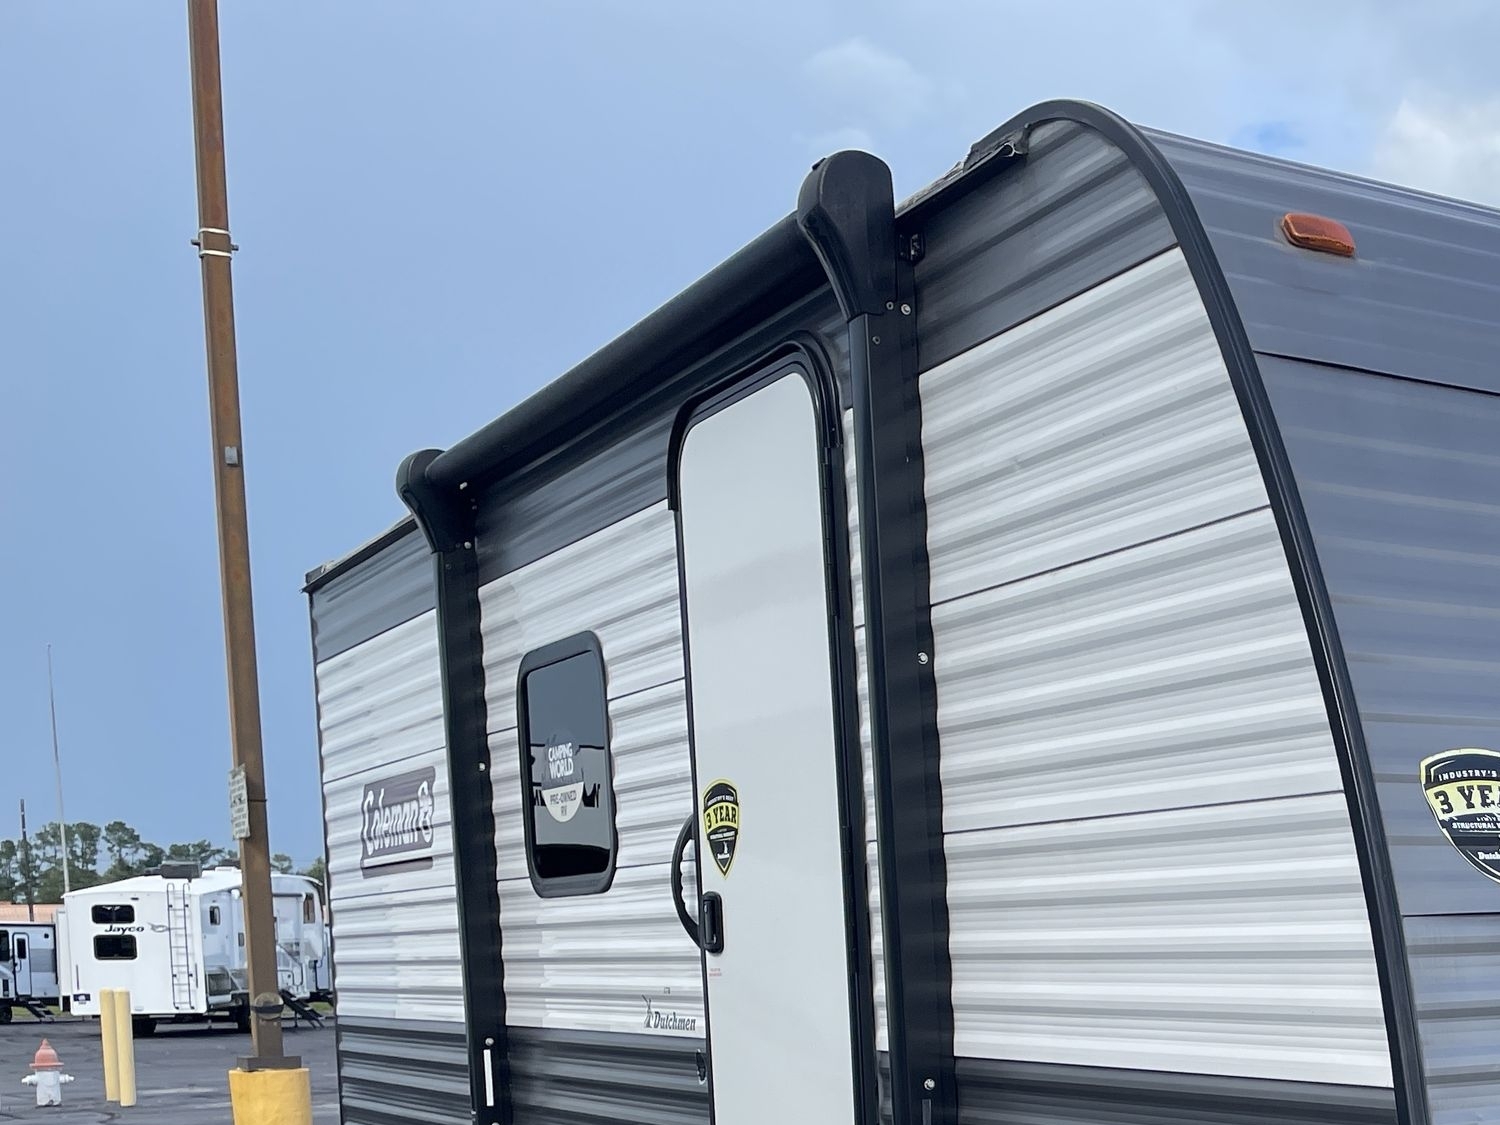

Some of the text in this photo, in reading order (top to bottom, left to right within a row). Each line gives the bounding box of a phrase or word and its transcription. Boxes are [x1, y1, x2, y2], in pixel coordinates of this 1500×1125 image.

[548, 742, 573, 762] CAMPING
[549, 758, 574, 779] WORLD
[1438, 769, 1497, 782] INDUSTRY'S
[1433, 789, 1454, 815] 3
[363, 788, 418, 856] Coleman
[706, 805, 737, 830] 3 YEAR
[104, 924, 145, 936] Jayco
[653, 1010, 697, 1031] Dutchmen
